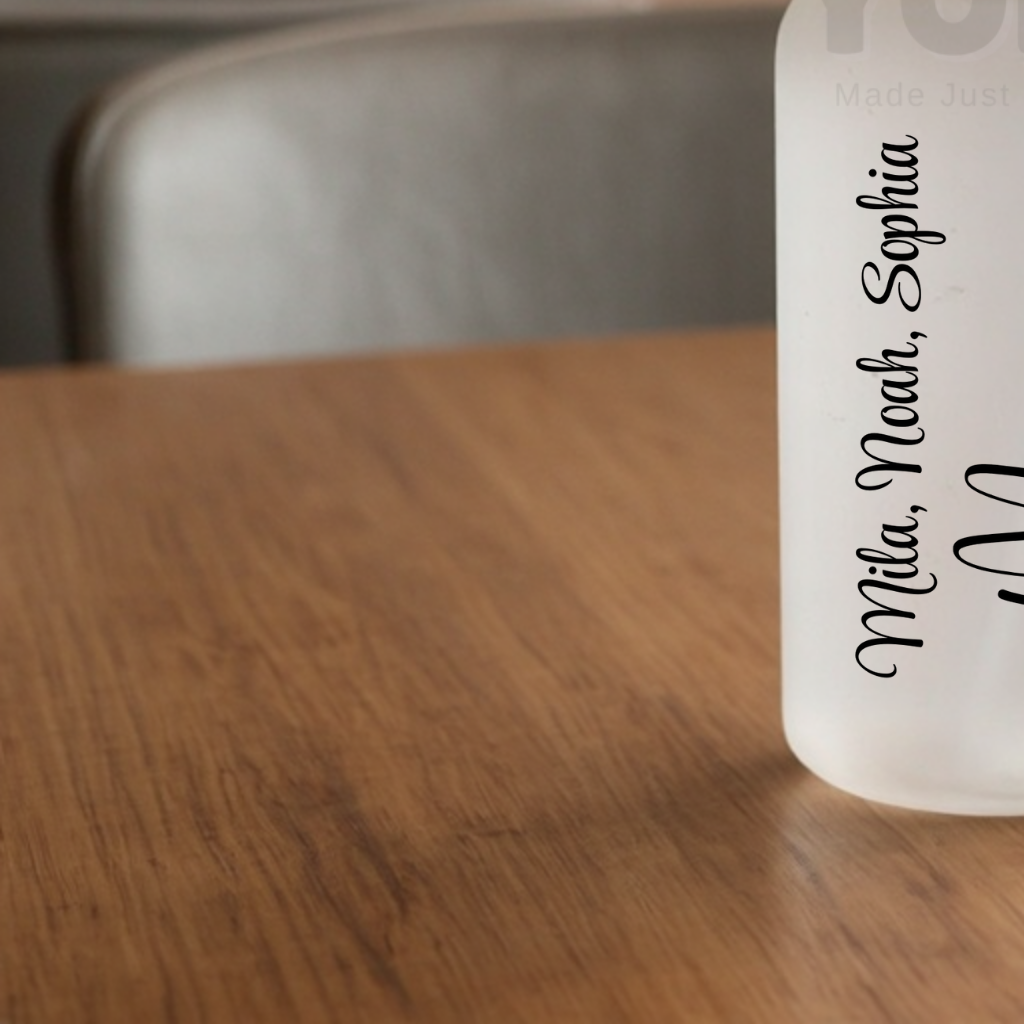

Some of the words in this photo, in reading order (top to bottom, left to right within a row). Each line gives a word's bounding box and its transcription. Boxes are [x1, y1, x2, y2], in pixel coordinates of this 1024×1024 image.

[855, 134, 947, 313] Sophia
[854, 331, 928, 491] Noah,
[854, 504, 938, 679] Mila,
